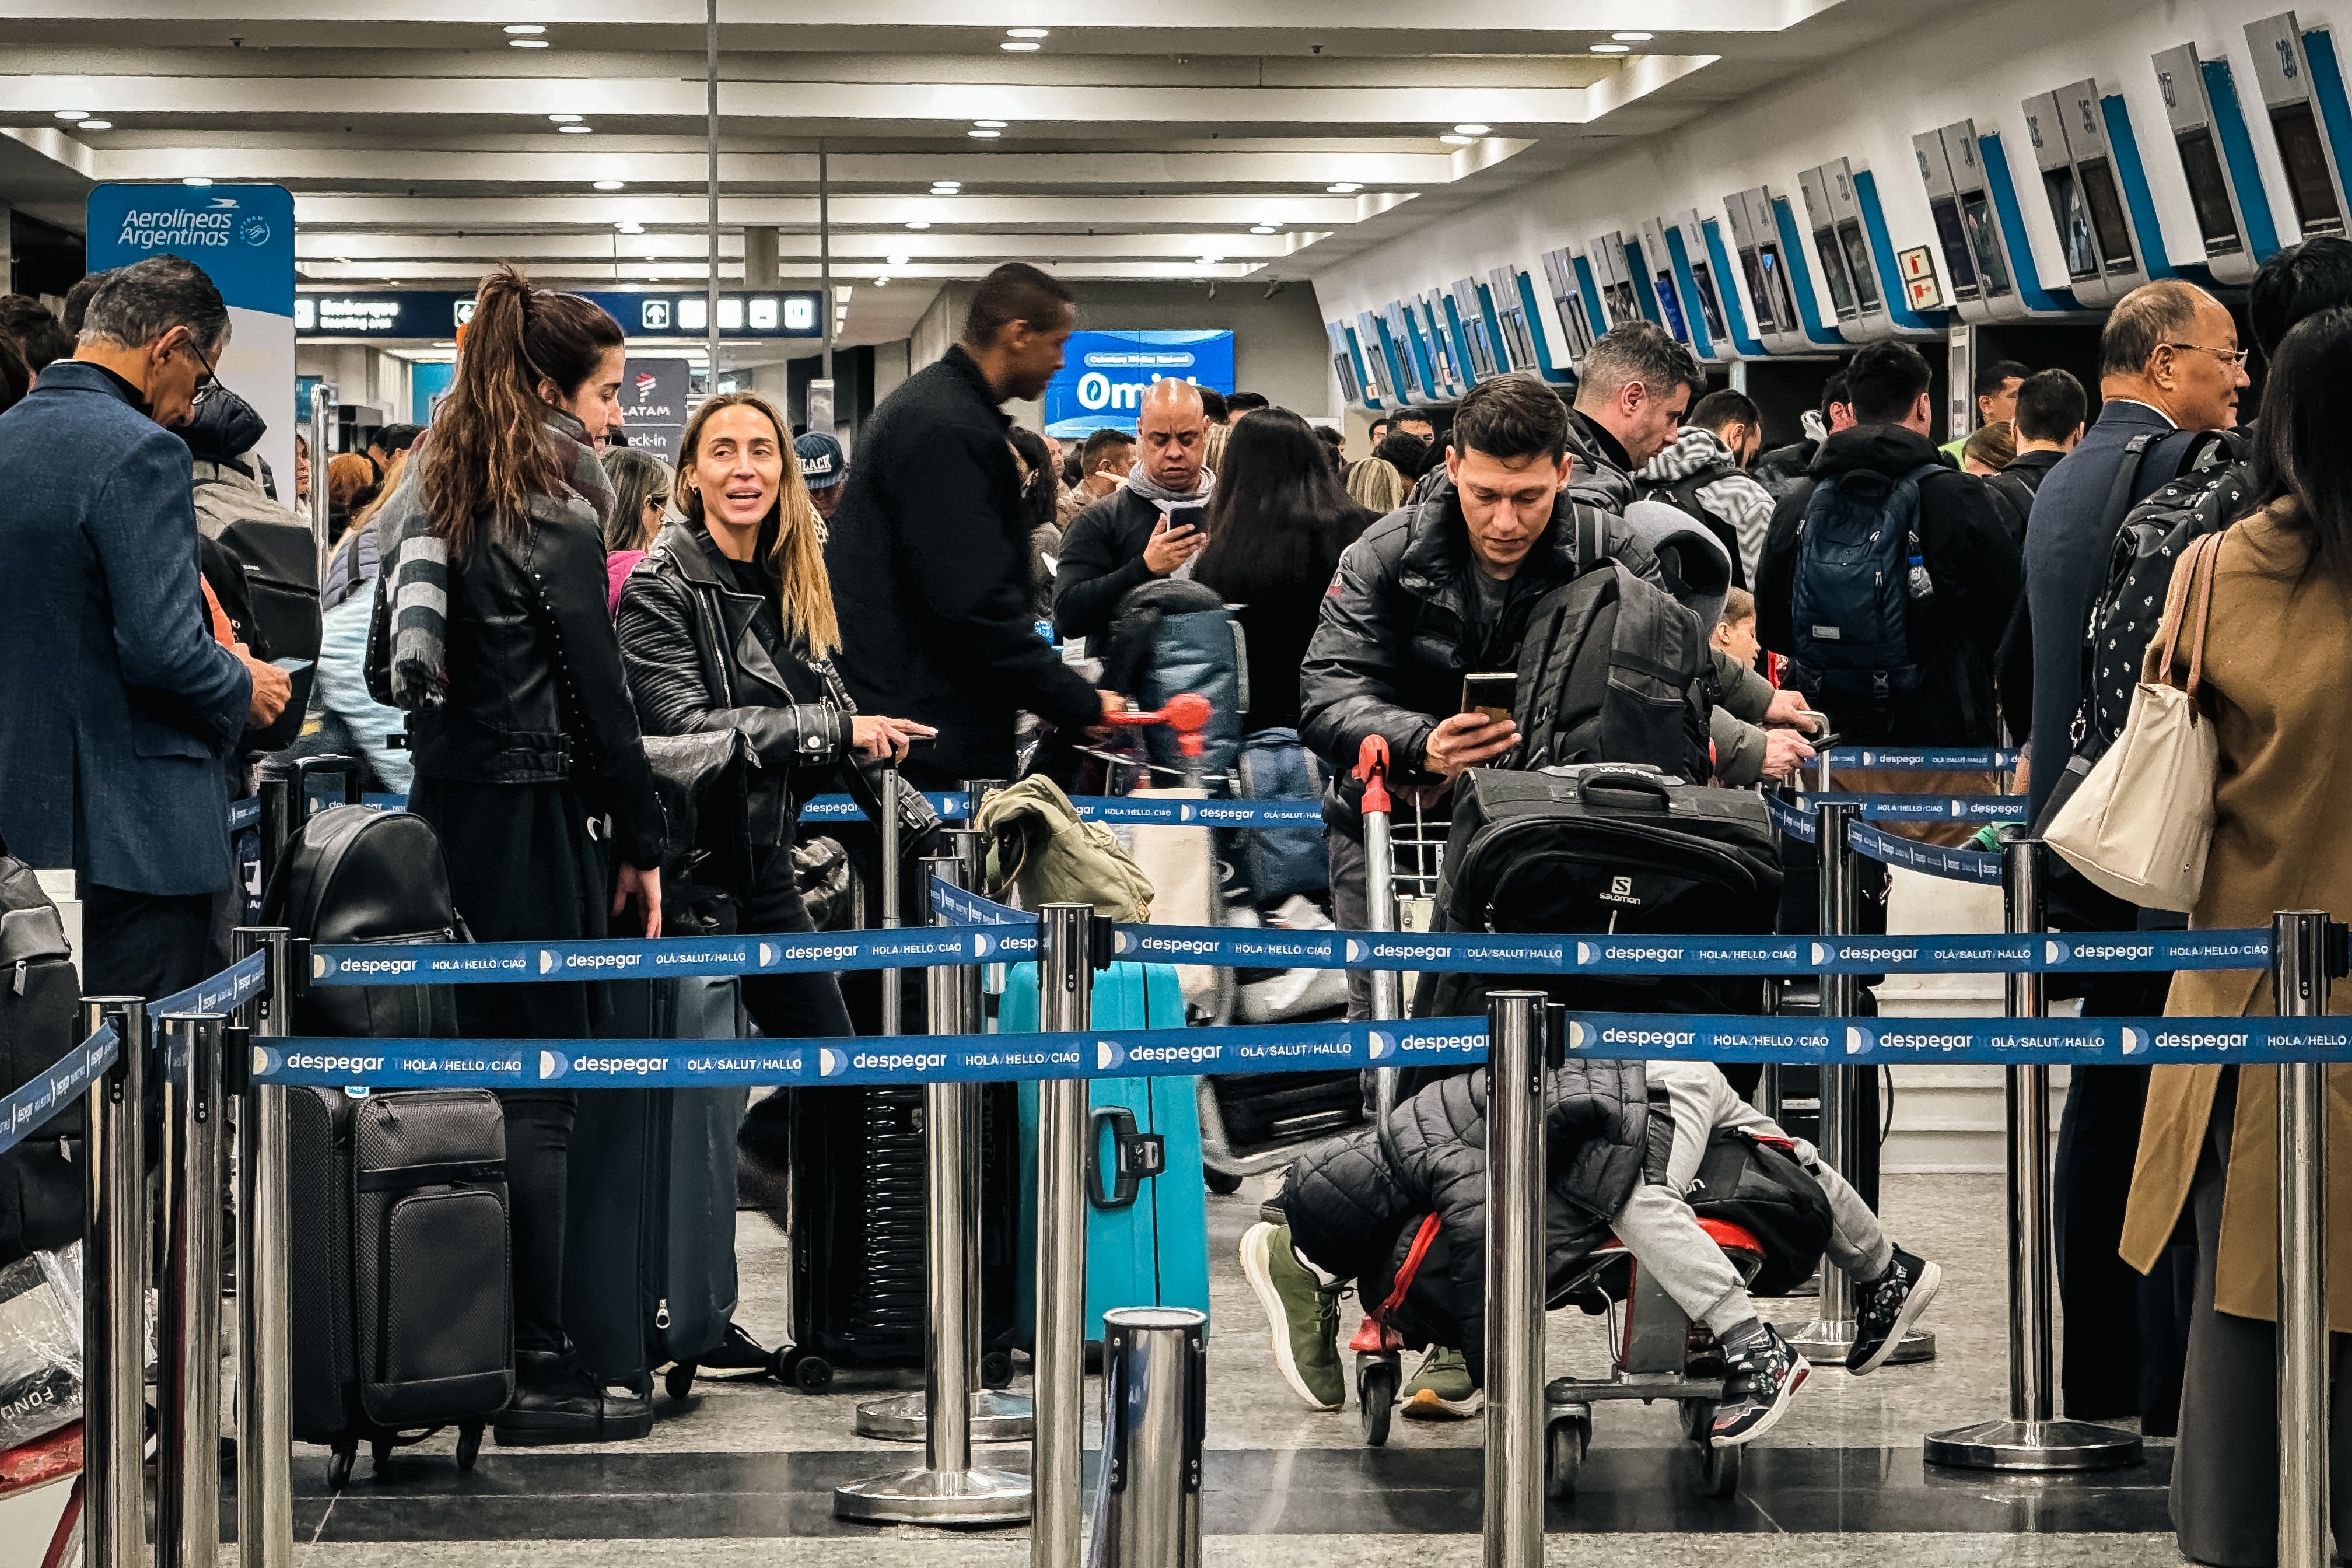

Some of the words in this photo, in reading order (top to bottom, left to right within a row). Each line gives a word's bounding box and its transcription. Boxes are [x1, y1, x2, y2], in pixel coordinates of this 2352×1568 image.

[122, 209, 233, 229] Aerolíneas
[117, 227, 229, 250] Argentinas
[621, 407, 670, 416] LATAM
[628, 433, 667, 447] eck-in
[1199, 808, 1254, 820] despegar
[1970, 803, 2023, 816] despegar
[340, 958, 418, 975] despegar
[566, 954, 642, 970] despegar
[785, 946, 859, 961] despegar
[1000, 936, 1037, 951] desp
[1142, 936, 1220, 955] despegar
[1373, 944, 1452, 961] despegar
[1605, 946, 1684, 963] despegar
[1839, 947, 1919, 963] despegar
[2074, 944, 2154, 960] despegar
[1602, 1027, 1696, 1048] despegar
[1879, 1032, 1973, 1052] despegar
[2155, 1031, 2249, 1051] despegar
[287, 1052, 384, 1074] despegar
[573, 1056, 669, 1076] despegar
[853, 1052, 947, 1072] despegar
[1130, 1045, 1223, 1064] despegar
